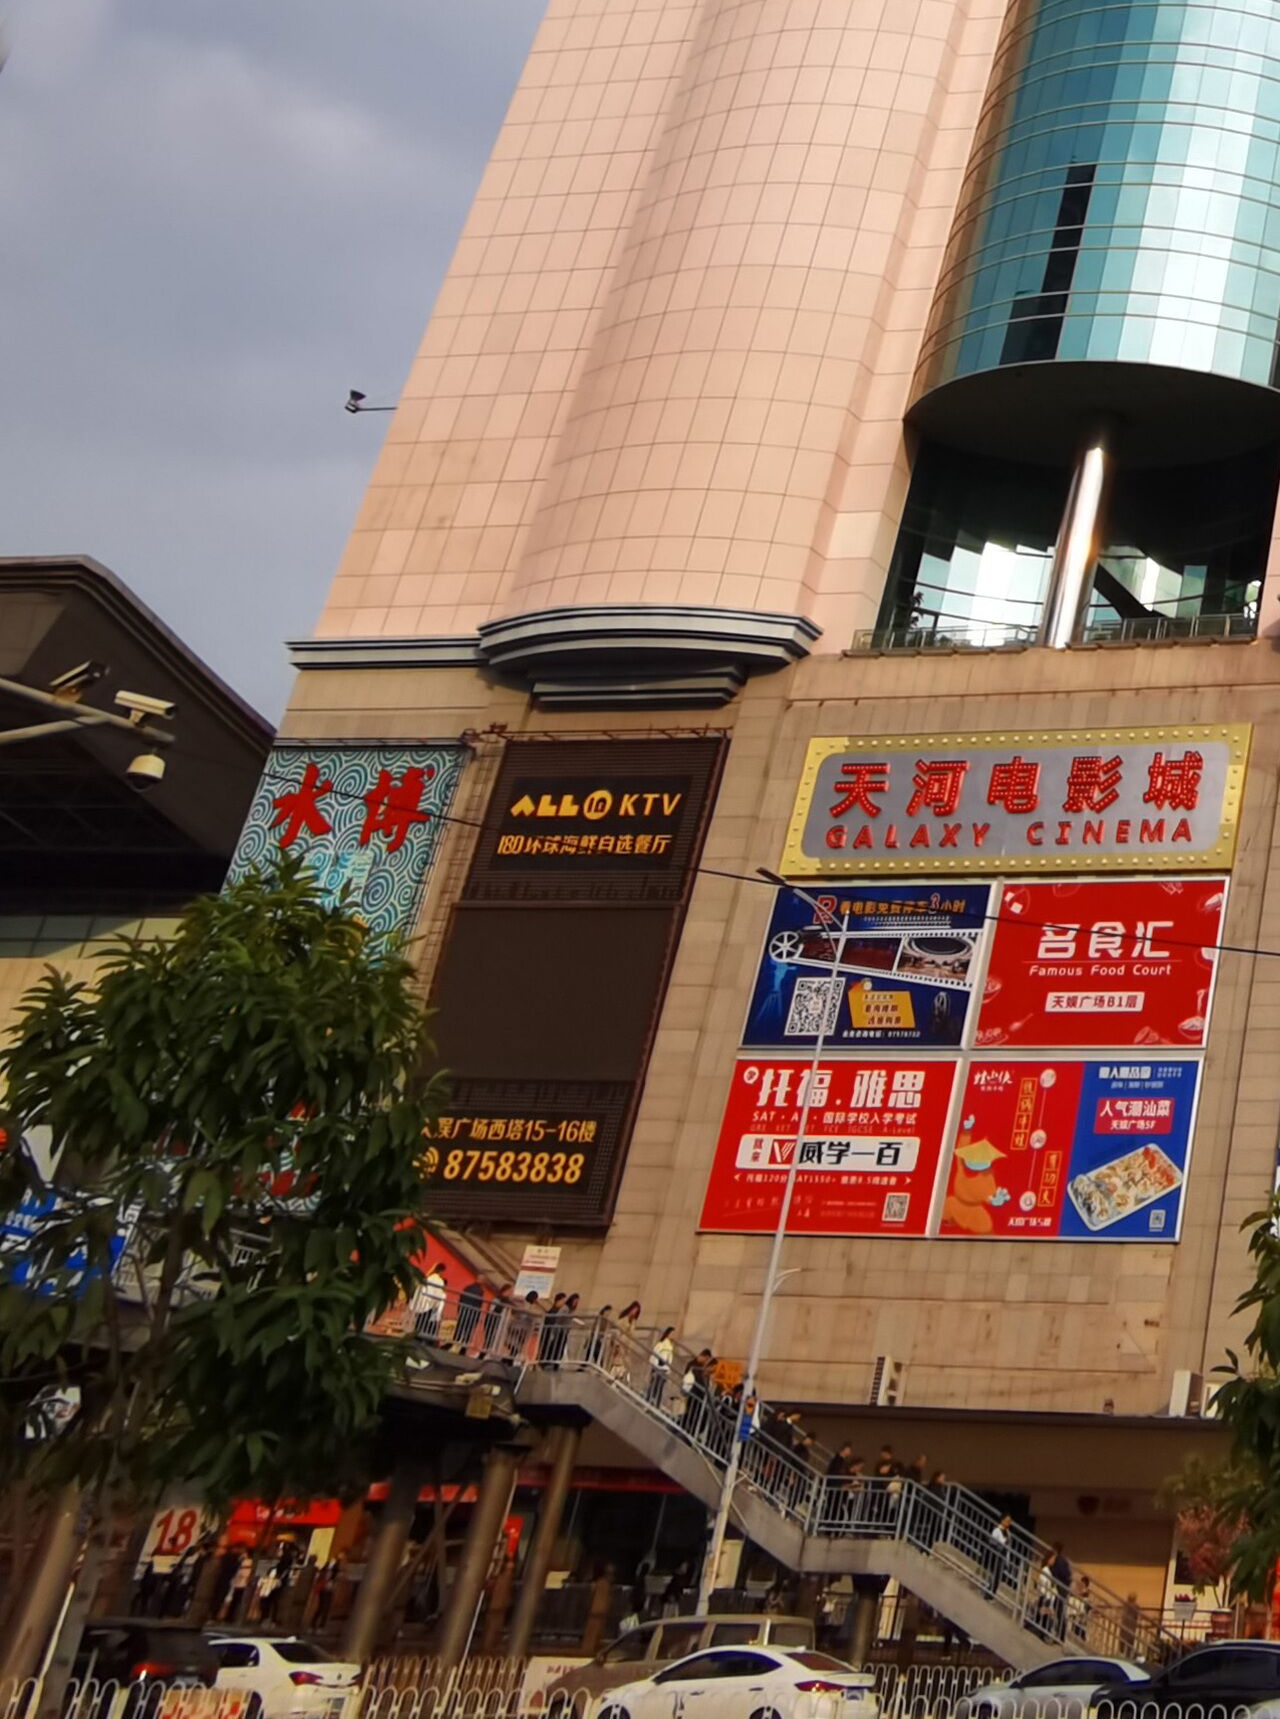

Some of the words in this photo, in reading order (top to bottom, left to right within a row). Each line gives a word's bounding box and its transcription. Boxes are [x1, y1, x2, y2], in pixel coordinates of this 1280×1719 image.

[828, 750, 1203, 818] 天河电影城
[619, 793, 682, 816] KTV
[825, 822, 991, 849] GALAXY
[1026, 818, 1192, 846] CINEMA
[1029, 964, 1082, 977] Famous
[1090, 964, 1125, 976] Food
[1133, 963, 1171, 976] Court
[752, 1111, 774, 1122] SAT
[443, 1149, 585, 1184] 87583838
